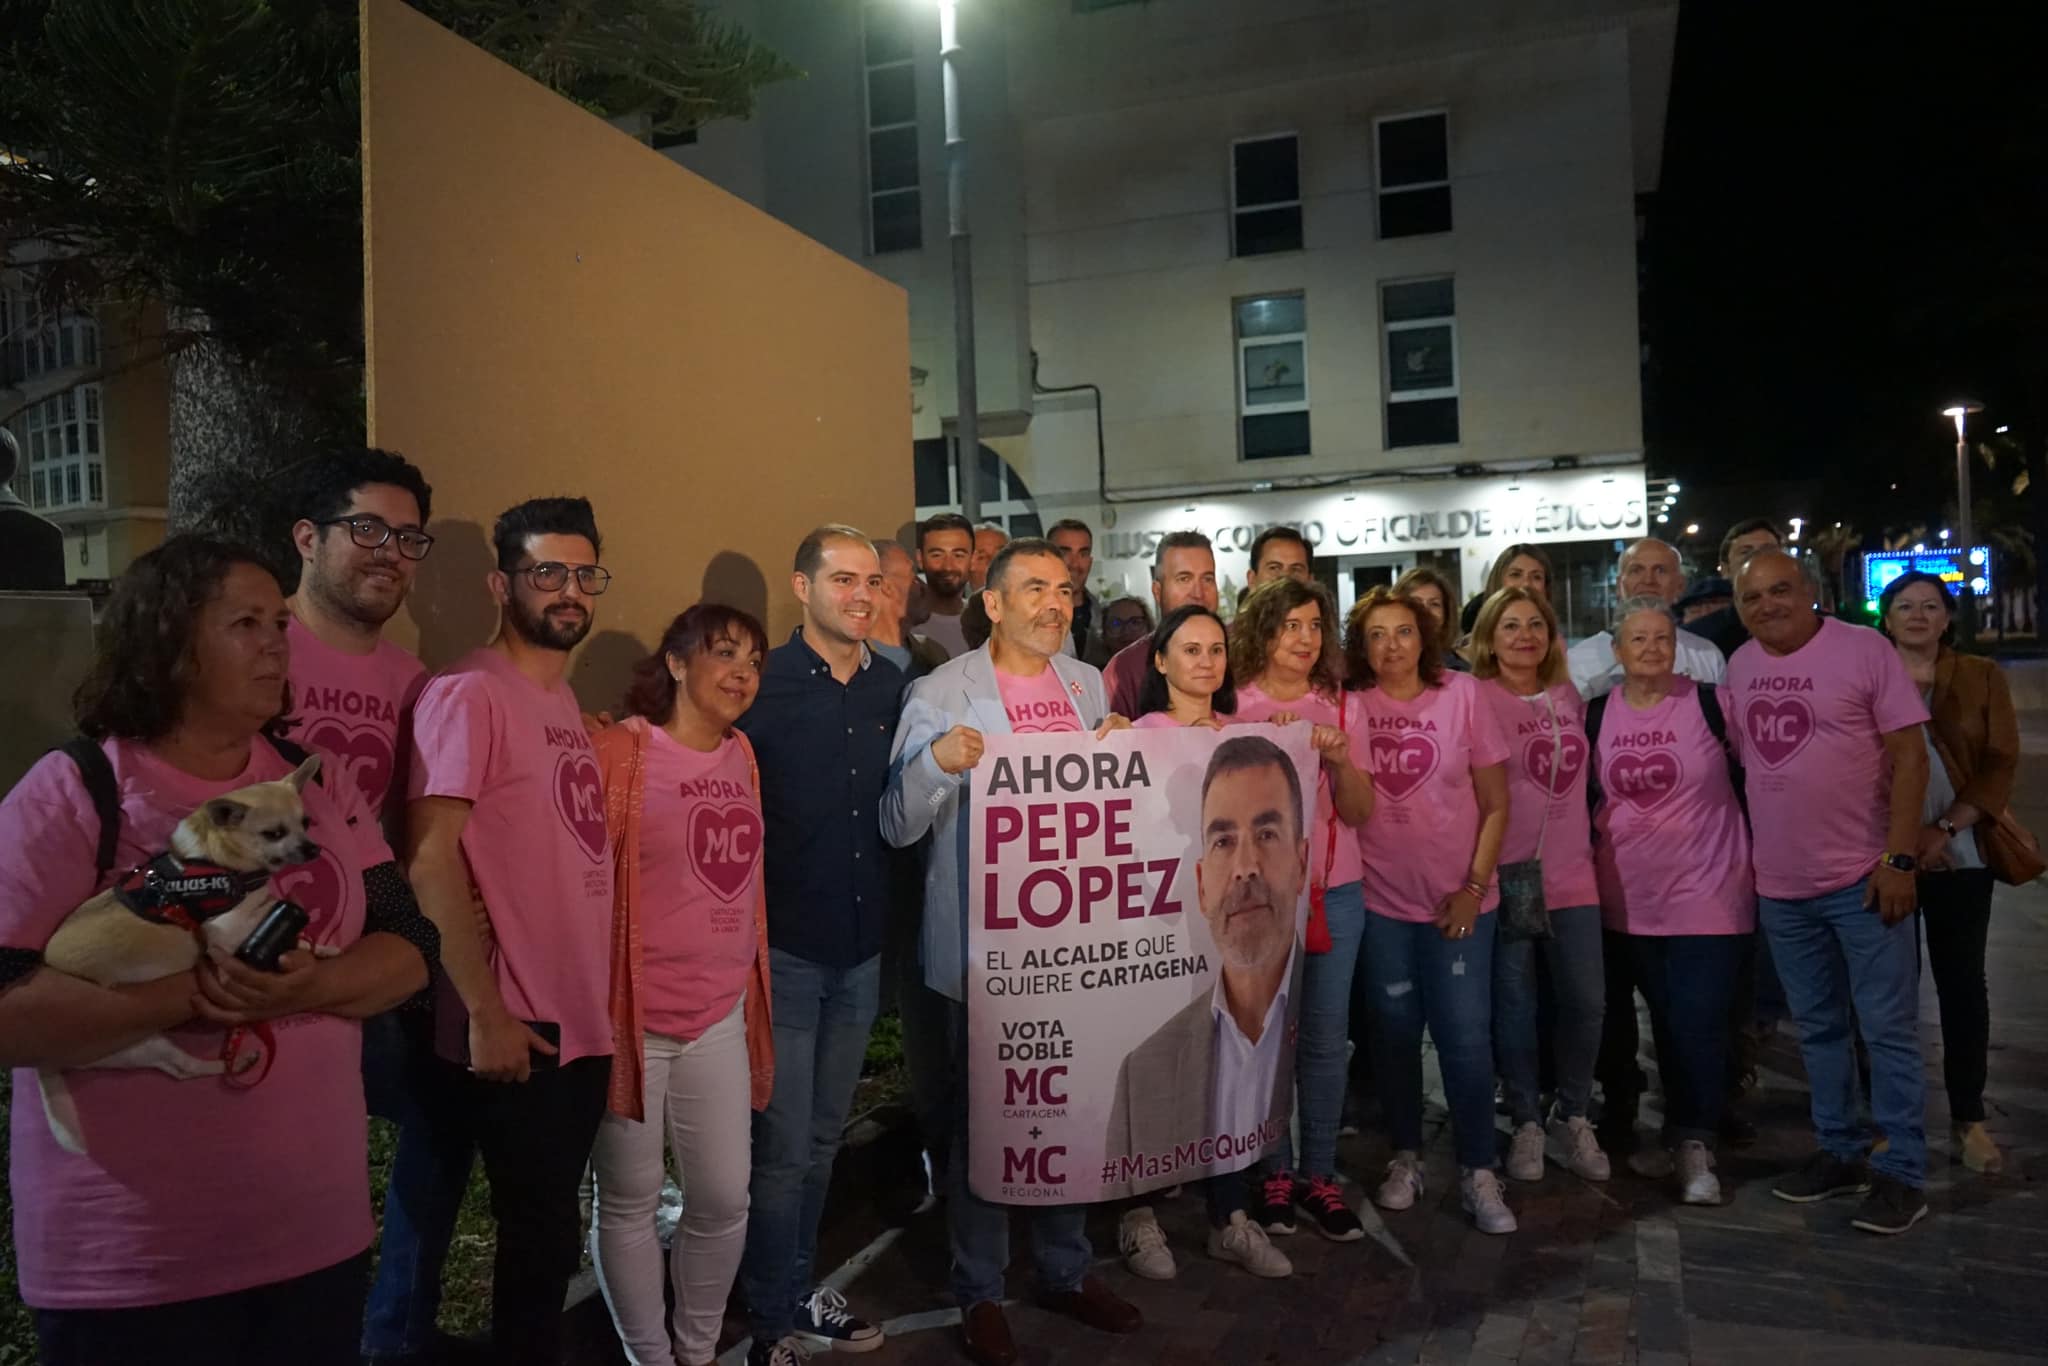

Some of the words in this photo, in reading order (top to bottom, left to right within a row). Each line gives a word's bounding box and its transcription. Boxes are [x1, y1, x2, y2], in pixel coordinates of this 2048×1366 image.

[1748, 676, 1814, 692] AHORA
[303, 686, 397, 726] AHORA
[1368, 716, 1438, 732] AHORA
[1754, 713, 1799, 742] MC
[1611, 730, 1678, 749] AHORA
[987, 751, 1152, 796] AHORA
[1373, 746, 1423, 775] MC
[679, 778, 750, 799] AHORA
[1619, 764, 1667, 791] MC
[702, 824, 751, 865] MC
[985, 799, 1133, 865] PEPE
[984, 857, 1182, 930] LÓPEZ
[986, 950, 1012, 971] EL
[1021, 940, 1128, 969] ALCALDE
[1134, 934, 1176, 957] QUE
[986, 972, 1073, 998] QUIERE
[1080, 955, 1209, 989] CARTAGENA
[1002, 1020, 1065, 1041] VOTA
[998, 1040, 1073, 1061] DOBLE
[1004, 1065, 1068, 1105] MC
[1003, 1108, 1067, 1119] CARTAGENA
[1003, 1146, 1066, 1185] MC
[1002, 1187, 1065, 1198] REGIONAL
